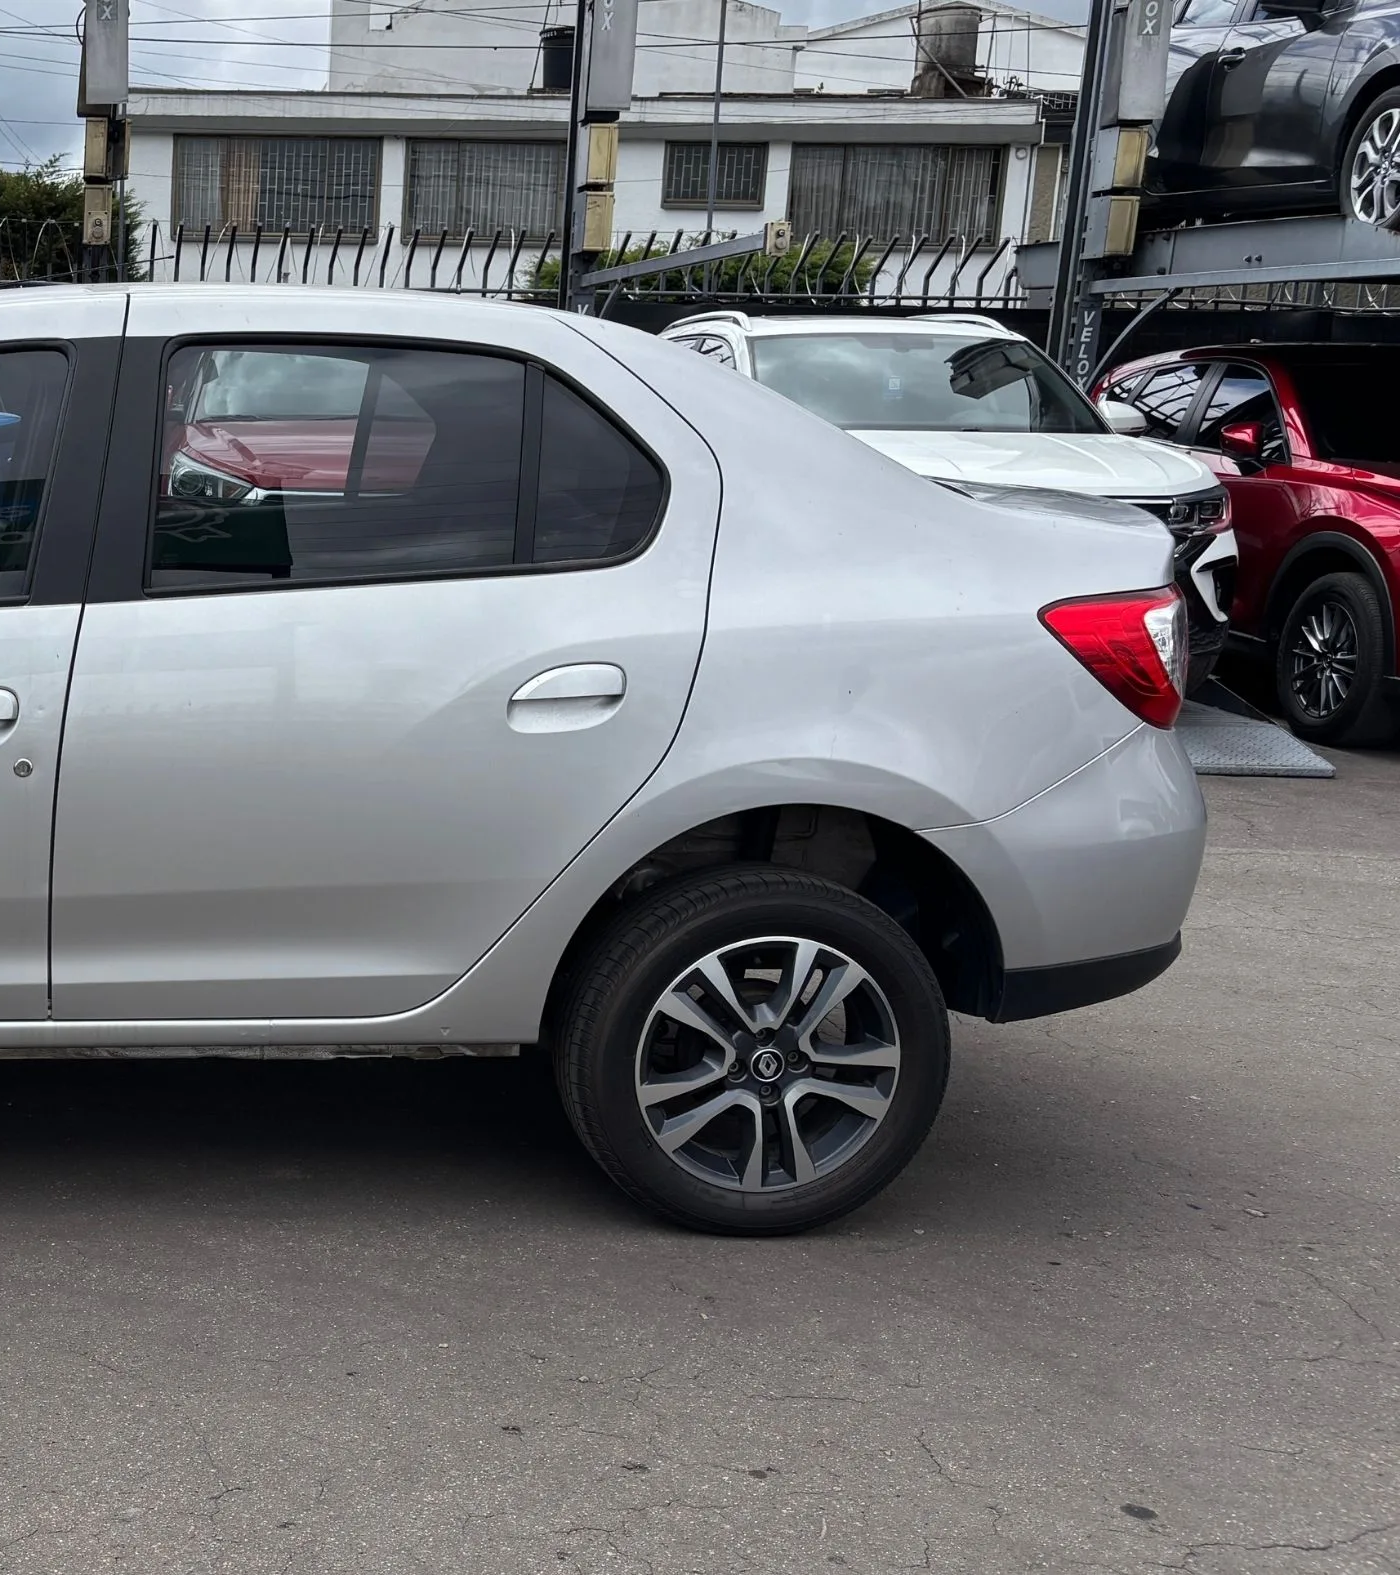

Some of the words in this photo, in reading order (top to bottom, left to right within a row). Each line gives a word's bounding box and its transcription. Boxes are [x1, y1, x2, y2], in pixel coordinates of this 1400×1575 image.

[101, 0, 113, 20] X
[1141, 1, 1159, 35] OX
[1076, 310, 1096, 393] VELOX
